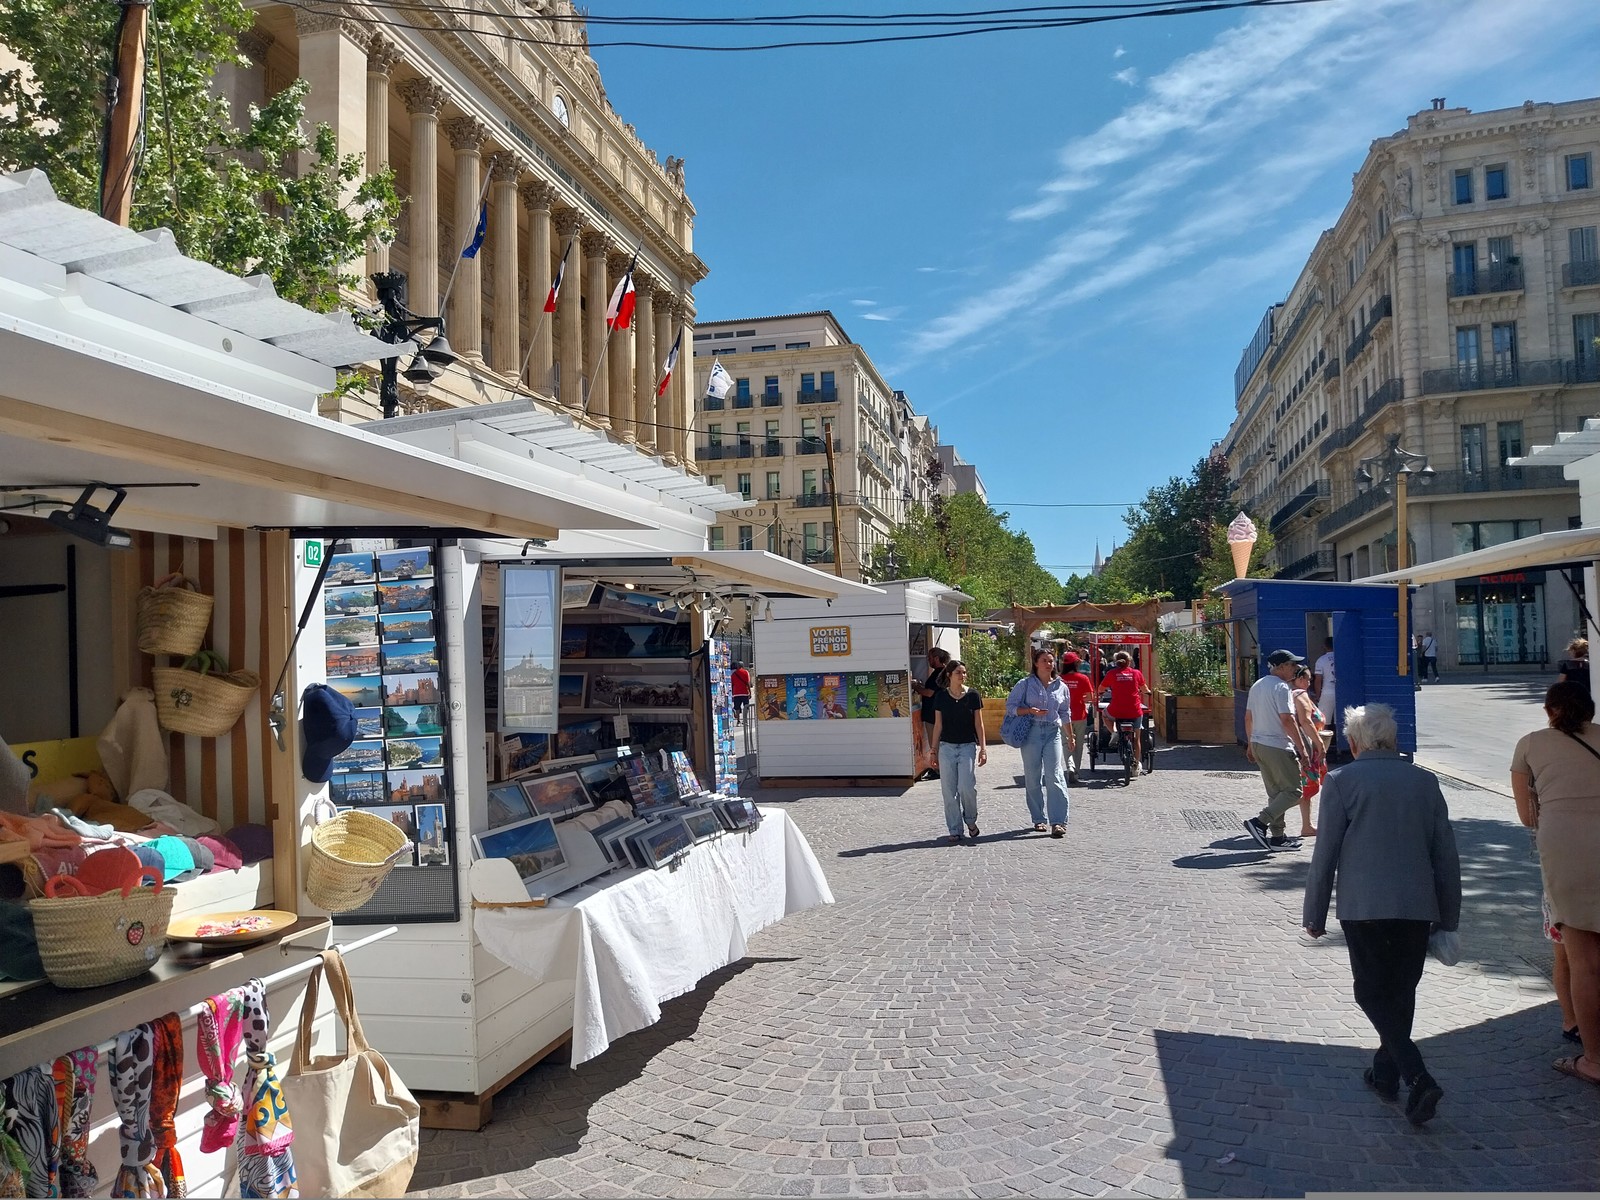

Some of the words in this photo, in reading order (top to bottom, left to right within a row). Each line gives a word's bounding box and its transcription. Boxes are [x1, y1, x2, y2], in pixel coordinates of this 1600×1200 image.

[509, 120, 533, 150] BOURSE
[536, 145, 544, 160] ET
[546, 156, 572, 187] CHAMBRE
[575, 181, 582, 194] DE
[584, 191, 610, 221] COMMERCE
[308, 545, 319, 561] 02
[812, 628, 847, 637] VOTRE
[814, 644, 829, 653] EN
[833, 643, 848, 652] BD
